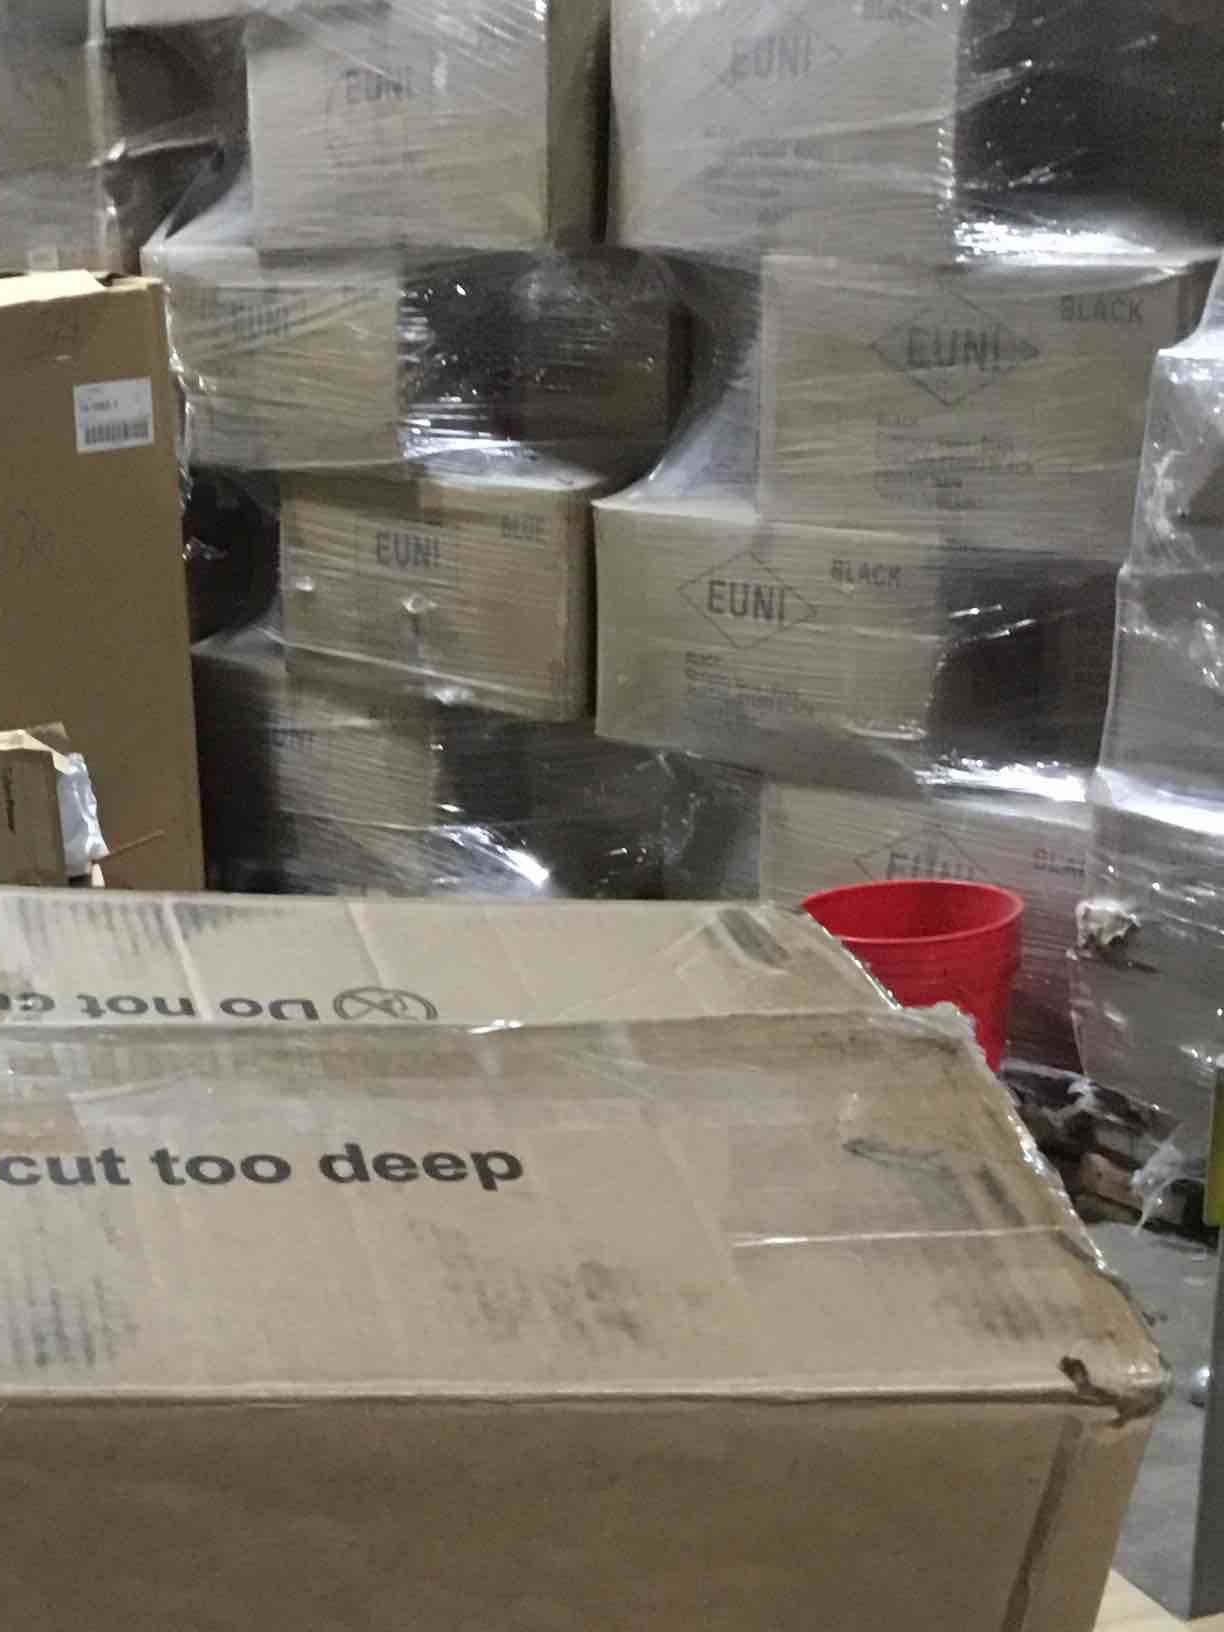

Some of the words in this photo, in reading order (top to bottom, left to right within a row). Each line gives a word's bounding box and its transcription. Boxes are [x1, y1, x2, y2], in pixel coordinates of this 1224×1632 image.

[1060, 294, 1144, 323] BLACK
[906, 327, 1001, 372] EUNI
[376, 528, 441, 568] EUNI
[830, 559, 902, 588] BLACK
[708, 580, 785, 622] EUNI
[76, 993, 197, 1018] not
[150, 1146, 292, 1186] too
[318, 1142, 524, 1191] deep
